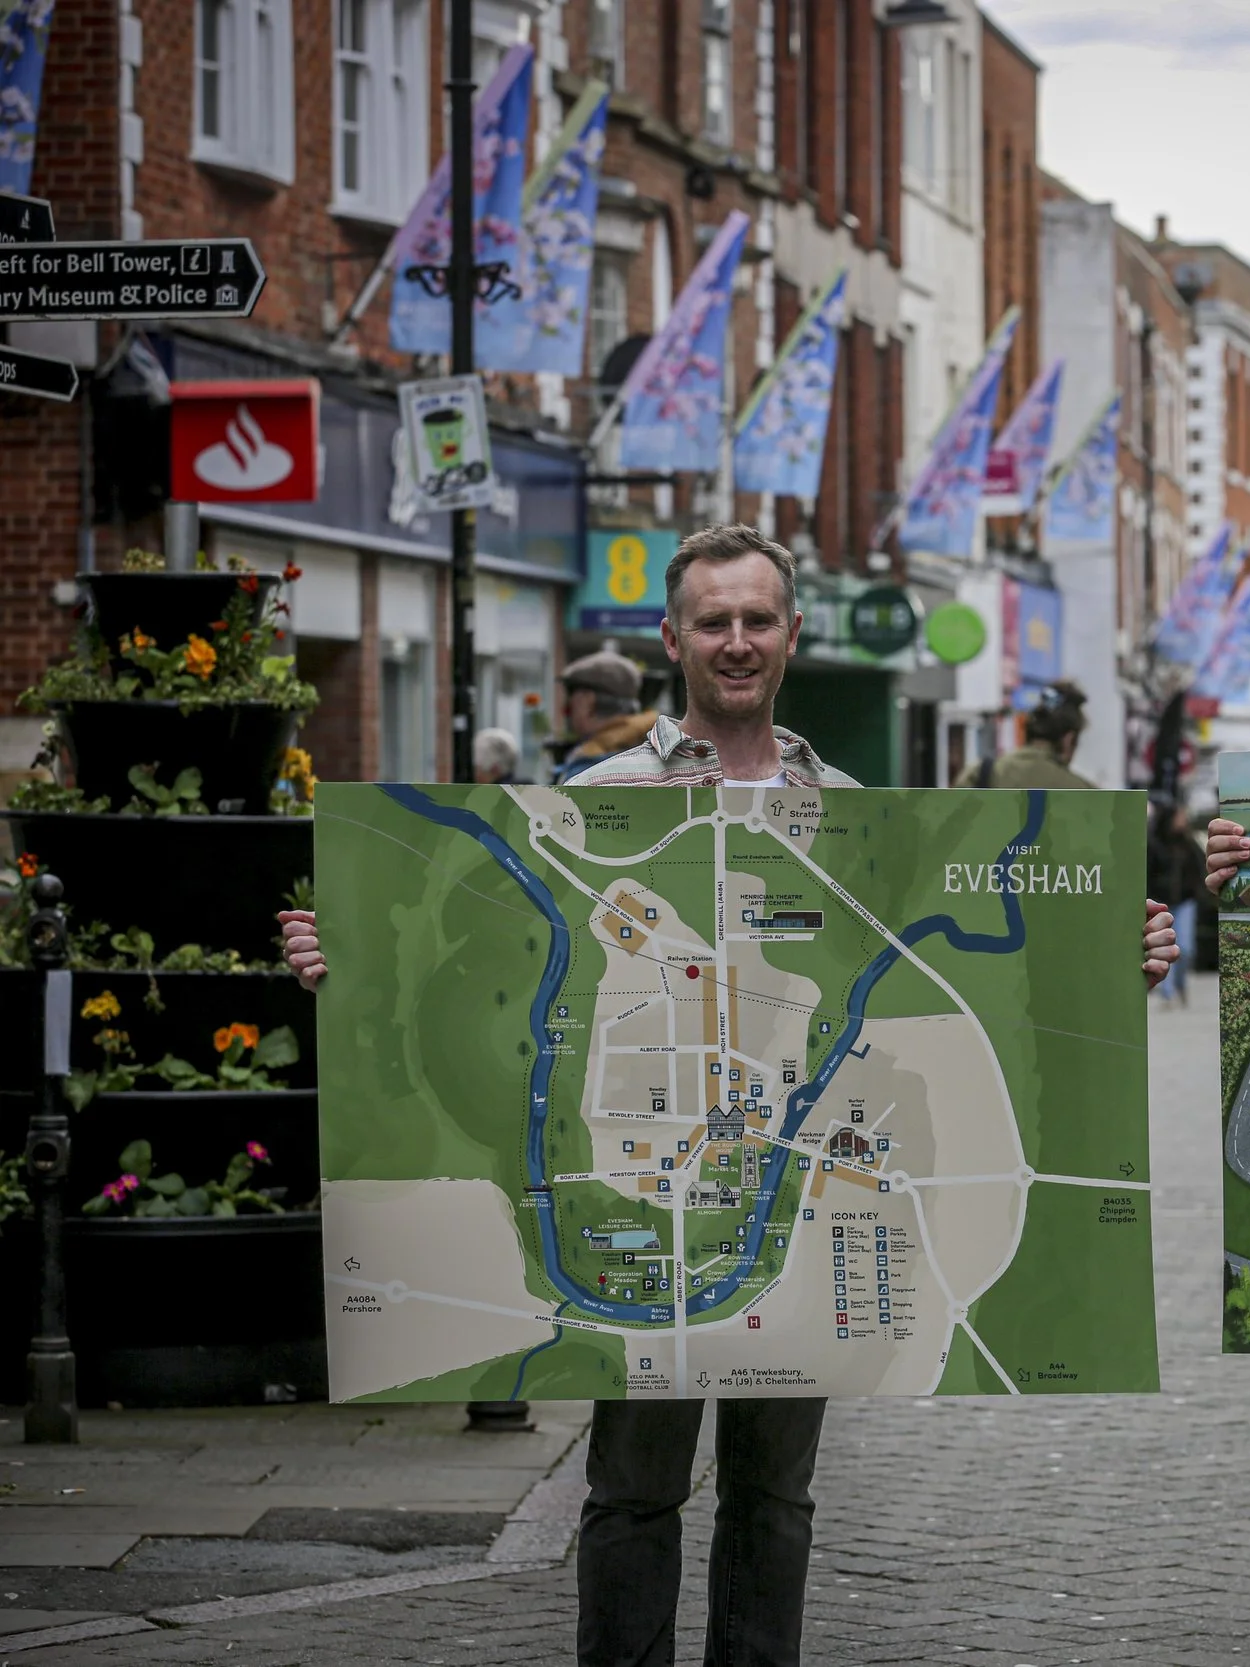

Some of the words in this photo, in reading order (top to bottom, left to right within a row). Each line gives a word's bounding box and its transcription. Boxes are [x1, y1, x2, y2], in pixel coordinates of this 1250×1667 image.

[32, 254, 61, 274] for
[67, 253, 104, 274] Bell
[109, 253, 176, 276] Tower,
[28, 286, 115, 307] Museum
[145, 286, 207, 304] Police
[800, 801, 818, 809] A46
[585, 813, 629, 821] Worcester
[789, 810, 829, 818] Stratford
[595, 822, 609, 830] M5
[611, 821, 629, 831] (J6)
[805, 826, 821, 834] The
[823, 826, 849, 835] Valley
[659, 830, 680, 848] SQUIRES
[1006, 845, 1041, 855] VISIT
[505, 857, 519, 872] River
[516, 869, 529, 884] Avon
[943, 863, 1103, 895] EVESHAM
[590, 891, 620, 915] WORCESTER
[619, 910, 634, 923] ROAD
[829, 881, 855, 906] EVESHAM
[853, 904, 875, 924] BYPASS
[633, 1001, 649, 1012] ROAD
[819, 1067, 831, 1083] River
[829, 1054, 840, 1070] Avon
[751, 1130, 772, 1142] BRIDGE
[769, 1135, 791, 1147] STREET
[684, 1155, 695, 1170] VINE
[691, 1141, 706, 1158] STREET
[838, 1159, 853, 1169] PORT
[852, 1164, 873, 1175] STREET
[1103, 1197, 1132, 1205] B4035
[1099, 1206, 1136, 1215] Chipping
[831, 1212, 856, 1220] ICON
[860, 1212, 879, 1220] KEY
[1098, 1215, 1138, 1225] Campden
[346, 1295, 376, 1304] A4084
[741, 1293, 766, 1315] WATERSIDE
[342, 1305, 382, 1313] Pershore
[583, 1298, 599, 1308] River
[599, 1304, 614, 1313] Avon
[552, 1317, 582, 1328] PERSHORE
[581, 1322, 598, 1331] ROAD
[731, 1368, 748, 1376] A46
[1037, 1372, 1078, 1380] Broadway
[719, 1377, 733, 1386] M5
[735, 1377, 753, 1387] (J9)
[764, 1377, 816, 1385] Cheltenham
